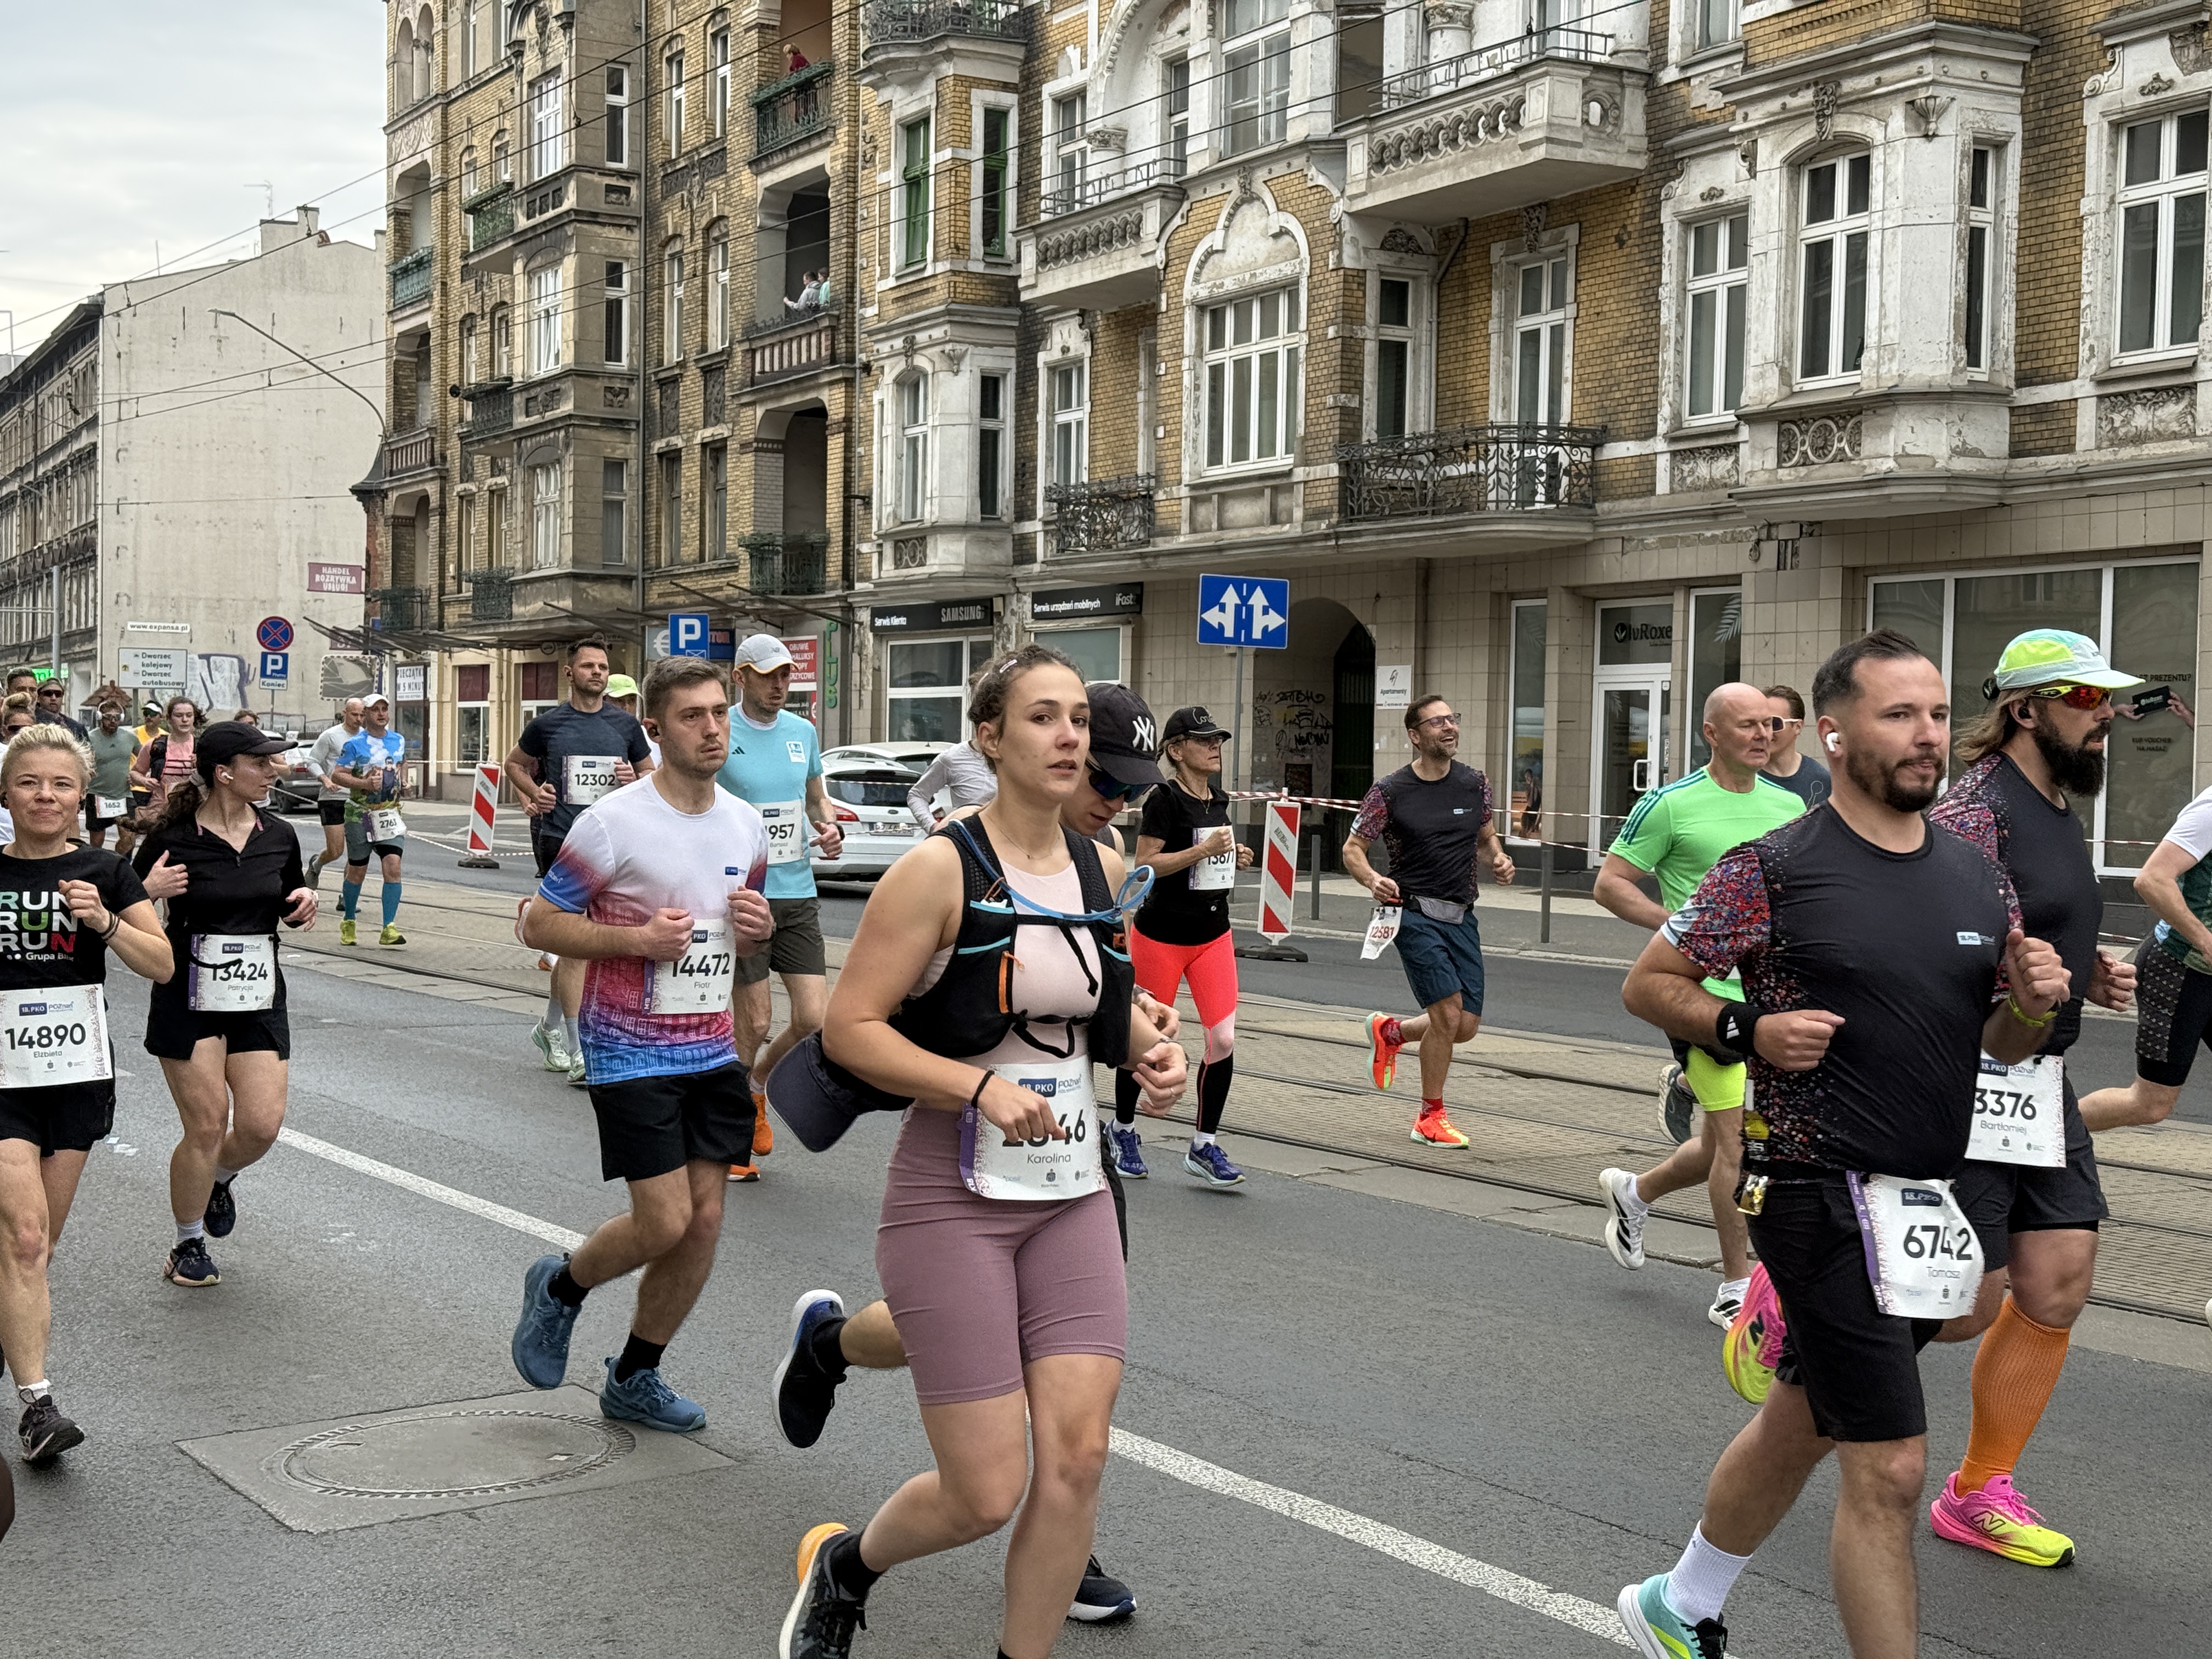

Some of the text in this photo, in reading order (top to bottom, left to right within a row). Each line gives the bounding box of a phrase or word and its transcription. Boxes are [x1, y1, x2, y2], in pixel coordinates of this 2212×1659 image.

[1034, 603, 1049, 613] Serwis
[1074, 598, 1101, 611] mobilnych
[874, 605, 981, 627] Serwis Klienta SAMSUNG
[679, 618, 701, 648] P
[142, 661, 172, 670] kolejowy
[266, 654, 283, 675] P
[792, 662, 808, 670] SOPY
[825, 619, 838, 709] PLUS
[2149, 674, 2192, 682] PREZENTU?
[575, 774, 616, 786] 12302
[0, 911, 78, 932] RUN
[0, 933, 76, 953] RUN
[26, 952, 55, 962] Grupa
[673, 952, 731, 978] 14472
[212, 962, 268, 981] 13424
[694, 981, 712, 989] Piotr
[5, 1023, 86, 1050] 14890
[1991, 1063, 2007, 1073] PKO
[1035, 1083, 1054, 1093] PKO
[1975, 1088, 2037, 1120] 3376
[1002, 1109, 1086, 1148] 46
[1027, 1153, 1071, 1164] Karolina
[1904, 1225, 1973, 1260] 6742
